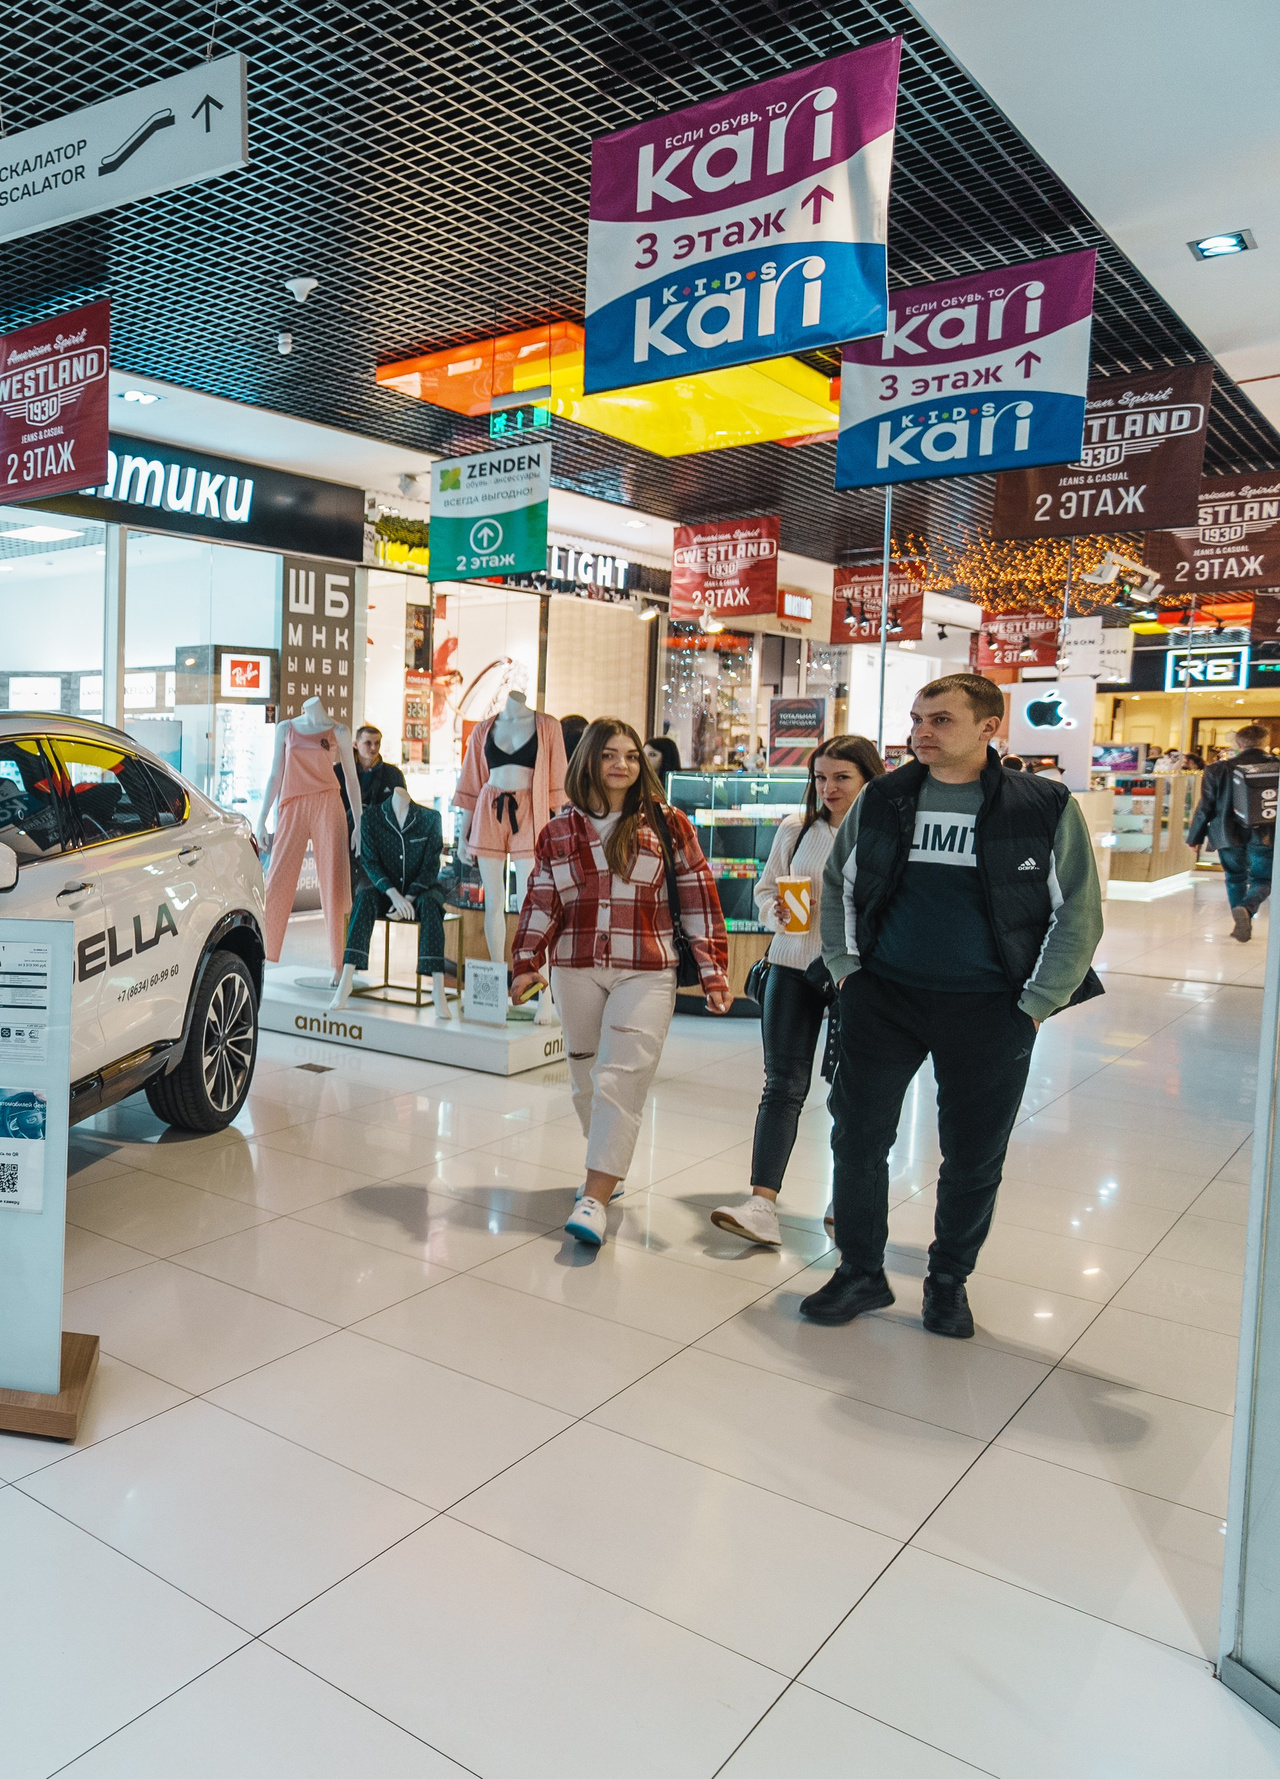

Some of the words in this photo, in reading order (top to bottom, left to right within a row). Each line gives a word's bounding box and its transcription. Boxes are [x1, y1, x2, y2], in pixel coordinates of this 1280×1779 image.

[665, 127, 703, 149] ЕСЛИ
[708, 110, 763, 136] ОБУВЬ,
[766, 101, 787, 118] ТО
[636, 86, 837, 213] kari
[634, 232, 659, 269] 3
[672, 208, 786, 260] этаж
[633, 255, 826, 363] kari
[905, 300, 937, 315] ЕСЛИ
[987, 288, 1004, 298] ТО
[881, 280, 1045, 360] kari
[7, 343, 52, 366] American
[53, 328, 88, 353] Spirit
[878, 375, 898, 401] 3
[911, 364, 1003, 397] этаж
[29, 396, 57, 422] 1930
[1118, 387, 1174, 409] Spirit
[21, 432, 38, 444] JEANS
[43, 425, 64, 439] CASUAL
[876, 400, 1034, 469] kari
[1084, 410, 1191, 443] TLAND
[7, 453, 18, 485] 2
[23, 439, 76, 481] ЭТАЖ
[467, 453, 540, 479] ZENDEN
[1074, 446, 1120, 467] 930
[1058, 475, 1085, 487] JEANS
[1095, 472, 1129, 483] CASUAL
[444, 495, 479, 507] ВСЕГДА
[481, 487, 533, 503] ВЫГОДНО!
[1034, 494, 1053, 521] 2
[1059, 484, 1147, 519] ЭТАЖ
[1203, 526, 1241, 542] 1930
[456, 556, 467, 571] 2
[470, 553, 515, 570] этаж
[683, 542, 770, 563] WESTLAND
[551, 546, 628, 590] LIGHT
[1175, 561, 1189, 583] 2
[1195, 554, 1265, 581] ЭТАЖ
[289, 568, 315, 615] Ш
[325, 573, 350, 618] Б
[692, 590, 702, 610] 2
[704, 586, 750, 608] ЭТАЖ
[288, 622, 303, 647] М
[312, 624, 326, 649] Н
[335, 627, 349, 650] К
[73, 903, 178, 984] ELLA
[127, 978, 149, 1000] (8634)
[294, 1013, 363, 1040] anima
